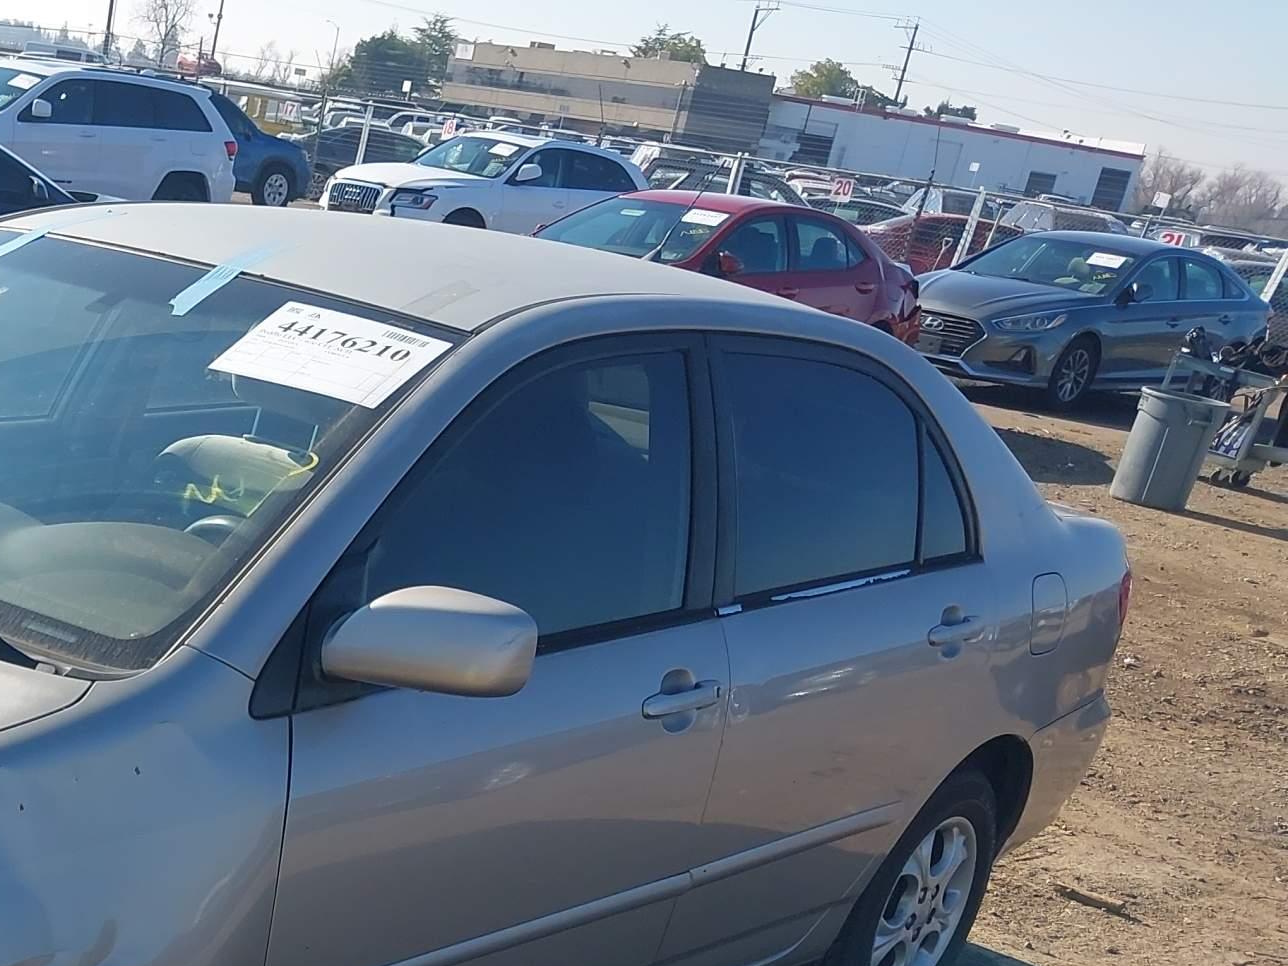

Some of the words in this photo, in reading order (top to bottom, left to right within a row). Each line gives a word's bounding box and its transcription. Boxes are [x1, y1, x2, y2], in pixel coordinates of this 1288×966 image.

[284, 103, 296, 115] 17
[443, 121, 456, 135] 18
[834, 180, 852, 196] 20
[1161, 233, 1183, 246] 21
[278, 320, 412, 362] 44176210
